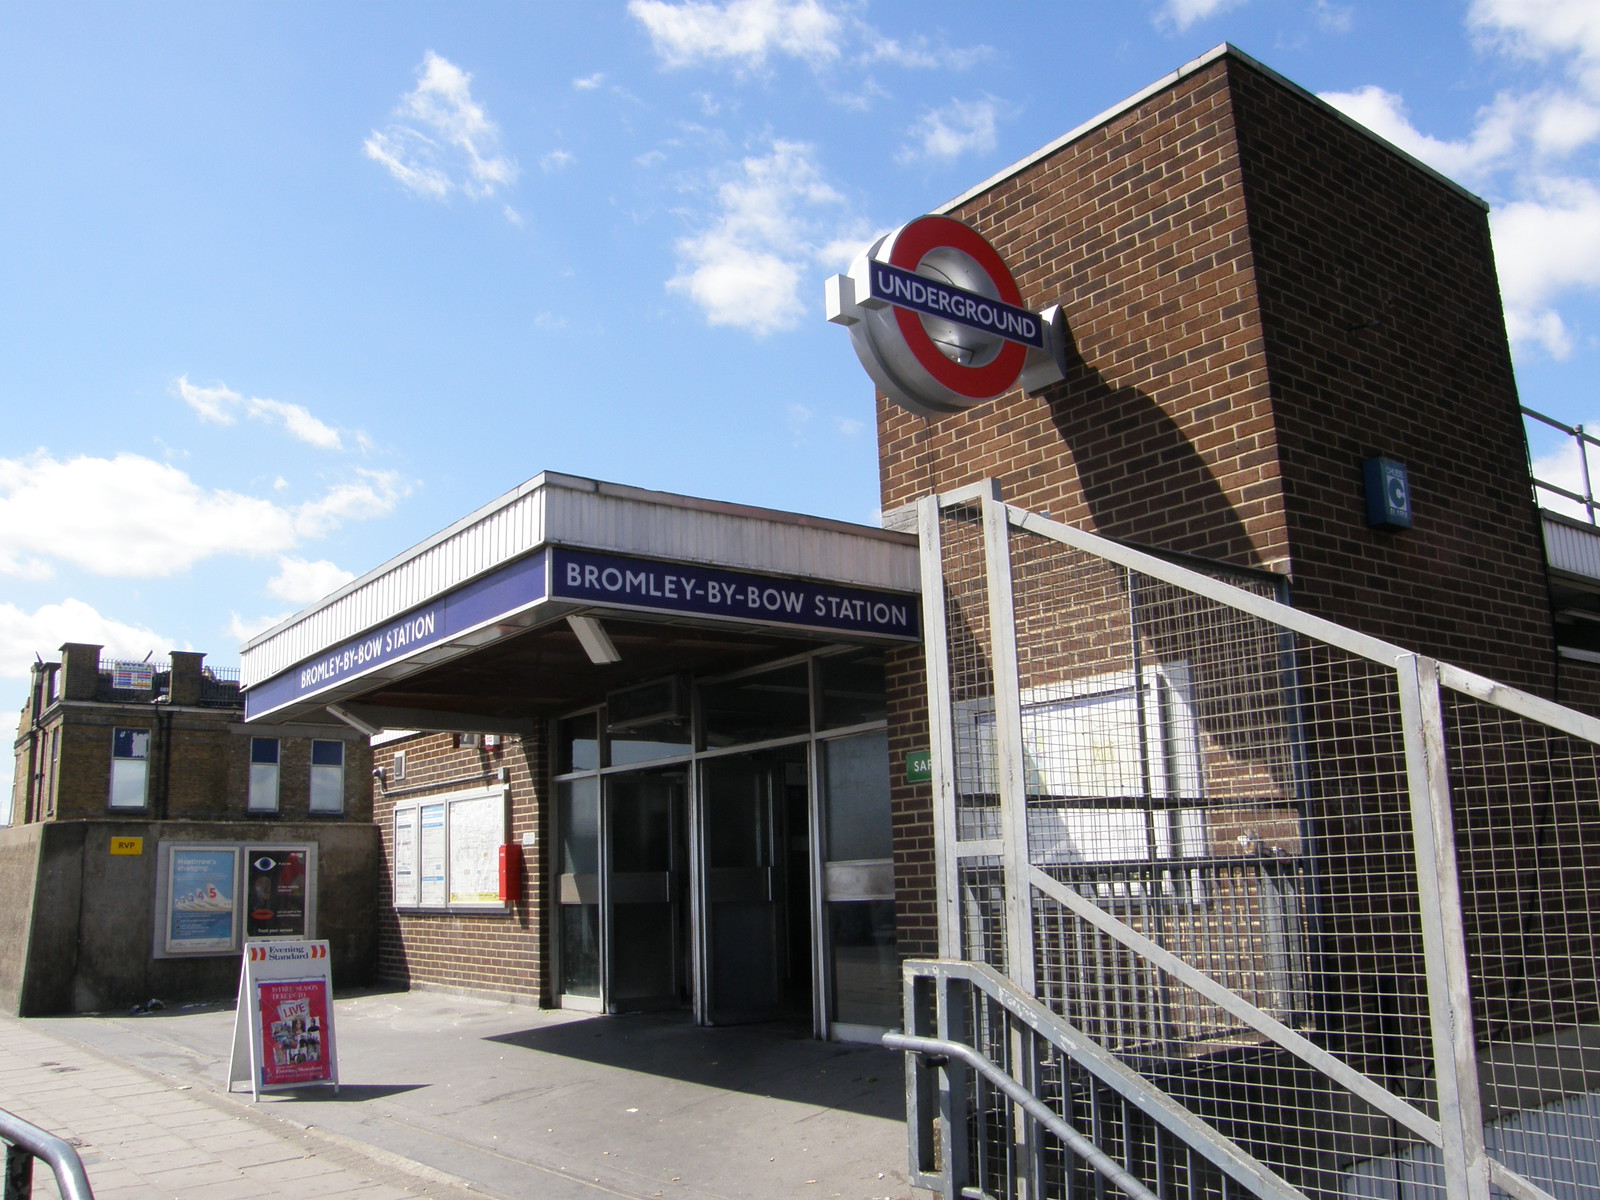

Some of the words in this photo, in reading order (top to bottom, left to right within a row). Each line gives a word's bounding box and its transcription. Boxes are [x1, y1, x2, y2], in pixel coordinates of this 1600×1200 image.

[877, 270, 1036, 338] UNDERGROUND
[566, 561, 804, 614] BROMLEY-BY-BOW
[814, 595, 908, 626] STATION
[300, 635, 384, 688] BROMLEY-BY-BOW
[385, 611, 435, 653] STATION
[118, 841, 136, 849] RVP
[197, 891, 204, 901] 4
[209, 887, 217, 899] 5
[268, 945, 304, 954] Evening
[268, 952, 309, 961] Standard
[283, 1002, 306, 1018] LIVE
